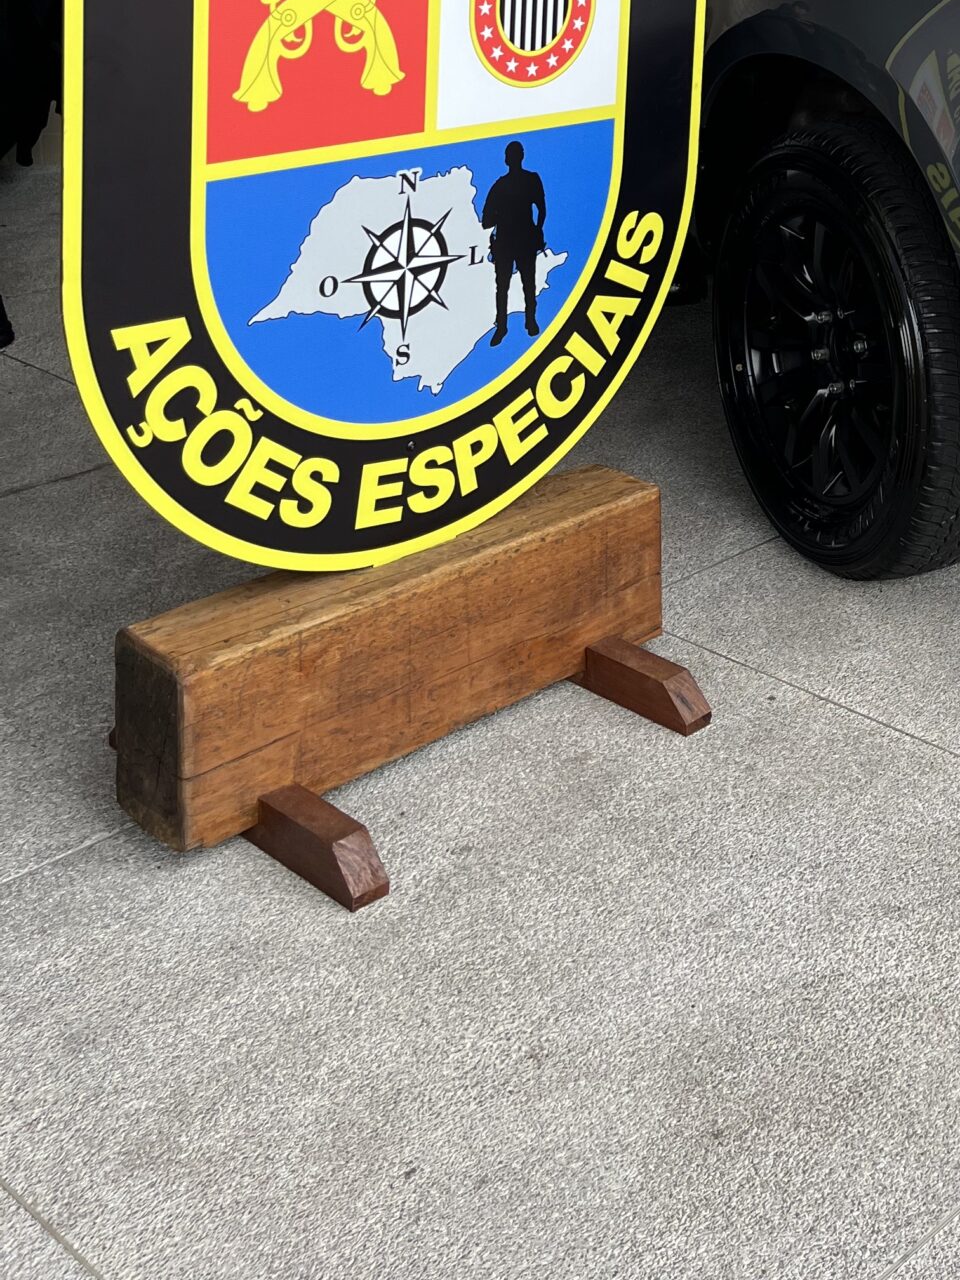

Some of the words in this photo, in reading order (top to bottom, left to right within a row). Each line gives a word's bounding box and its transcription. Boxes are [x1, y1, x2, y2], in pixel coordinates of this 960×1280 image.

[398, 171, 419, 195] N
[468, 245, 485, 266] L
[319, 275, 339, 298] O
[395, 344, 411, 367] S
[111, 316, 341, 529] AÇÕES
[355, 210, 665, 530] ESPECIAIS
